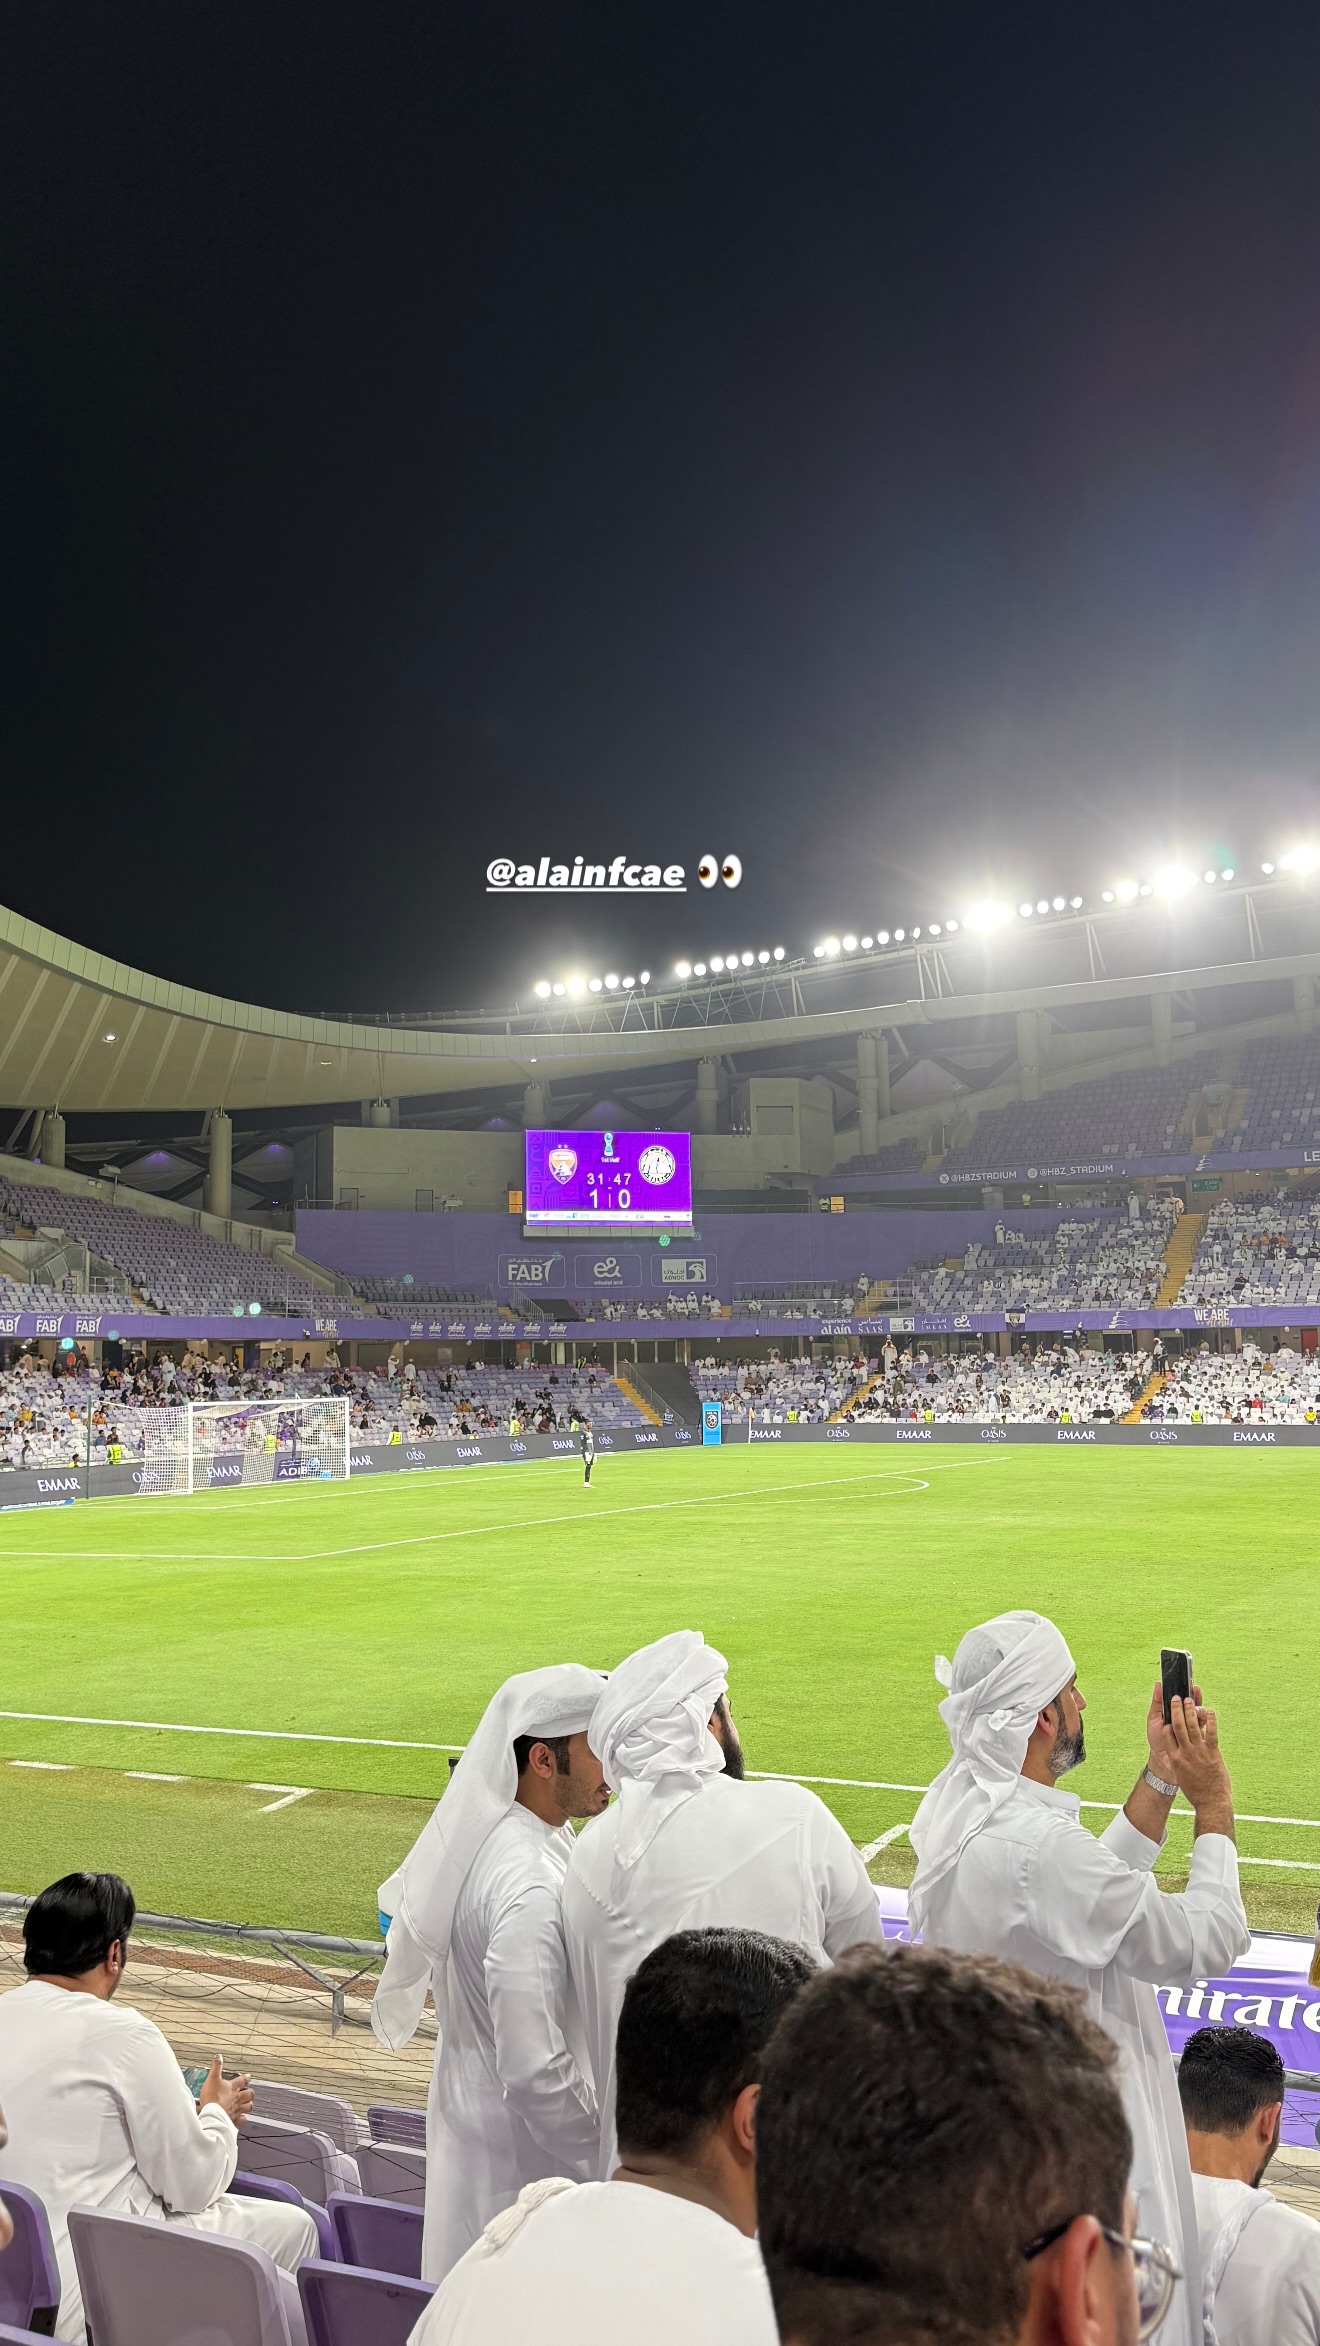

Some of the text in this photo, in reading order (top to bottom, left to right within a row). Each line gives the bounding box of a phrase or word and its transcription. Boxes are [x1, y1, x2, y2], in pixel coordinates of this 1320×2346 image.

[951, 1170, 1017, 1182] @HBZSTADIUM
[1039, 1164, 1114, 1176] @HBZ_STADIUM
[589, 1189, 598, 1209] 1
[618, 1189, 631, 1209] 0
[508, 1264, 543, 1280] FAB
[1194, 1309, 1209, 1321] WE
[1211, 1309, 1230, 1321] ARE
[36, 1319, 57, 1333] FAB
[76, 1320, 95, 1333] FAB
[315, 1319, 325, 1332] WE
[858, 1325, 883, 1334] SAAS
[750, 1430, 781, 1439] EMAAR
[827, 1430, 850, 1438] OASIS
[896, 1431, 932, 1439] EMAAR
[981, 1429, 1007, 1438] OASIS
[1057, 1431, 1096, 1440] EMAAR
[1150, 1431, 1178, 1440] OASIS
[1233, 1432, 1276, 1442] EMAAR
[37, 1477, 81, 1492] EMAAR
